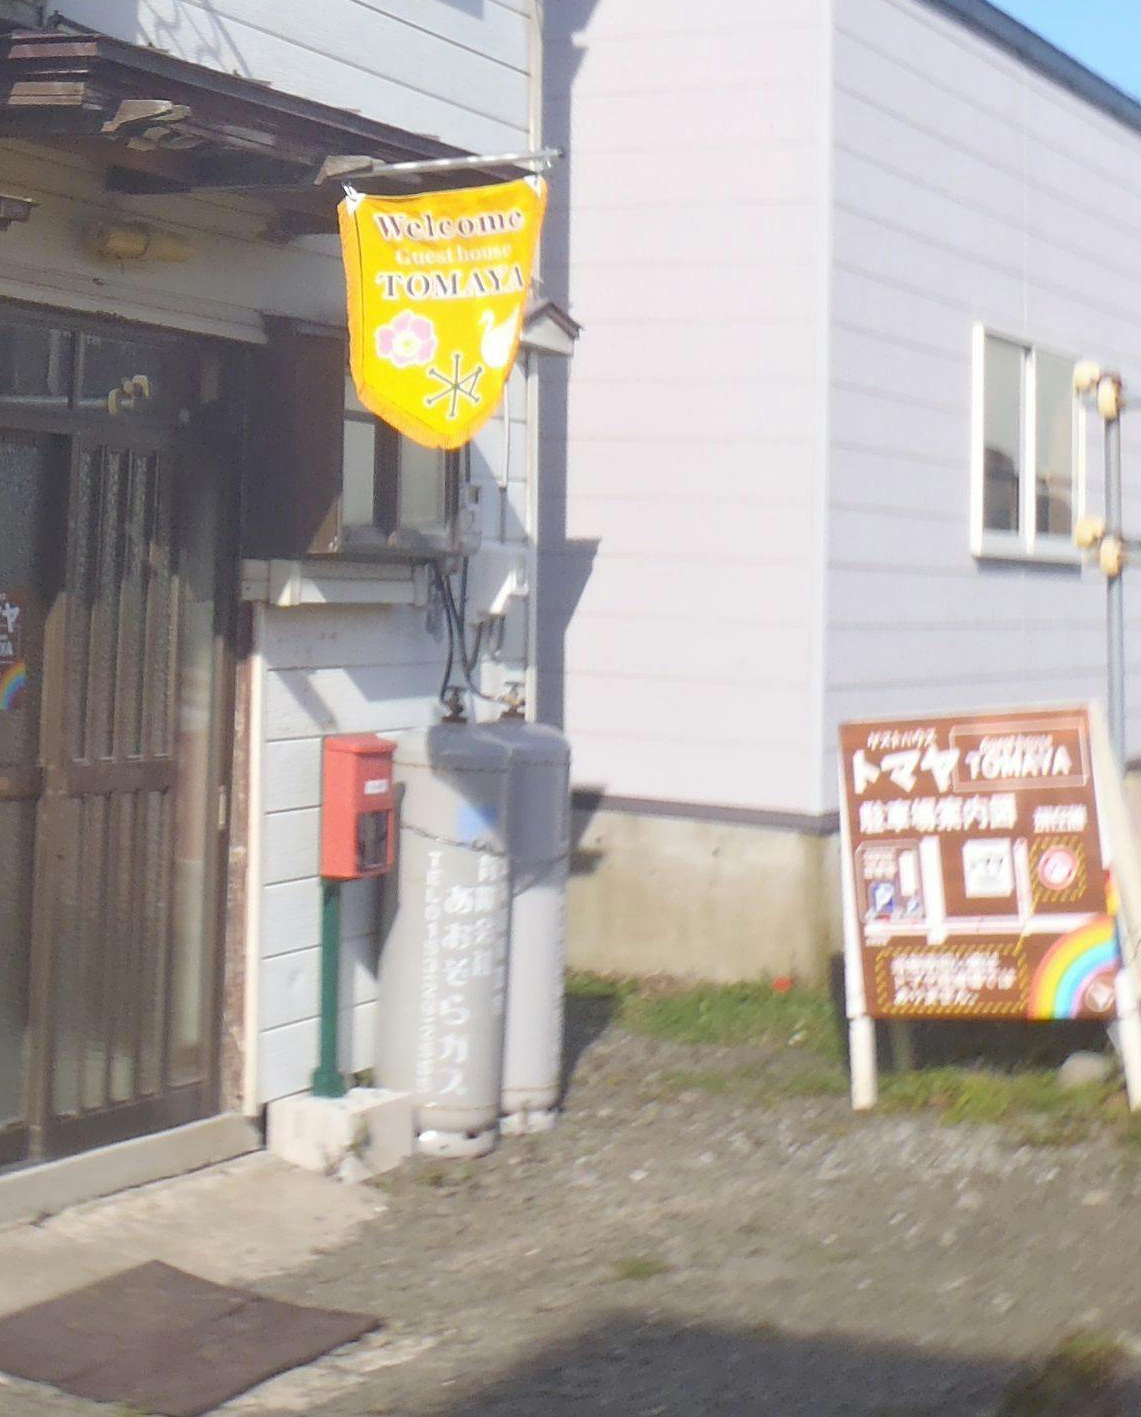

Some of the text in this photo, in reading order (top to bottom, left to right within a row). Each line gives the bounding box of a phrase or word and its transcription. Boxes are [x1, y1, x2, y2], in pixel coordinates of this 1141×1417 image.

[375, 210, 522, 239] Welcome
[378, 266, 524, 298] TOMAYA
[853, 745, 960, 794] トマヤ
[965, 745, 1073, 780] TOMAYA
